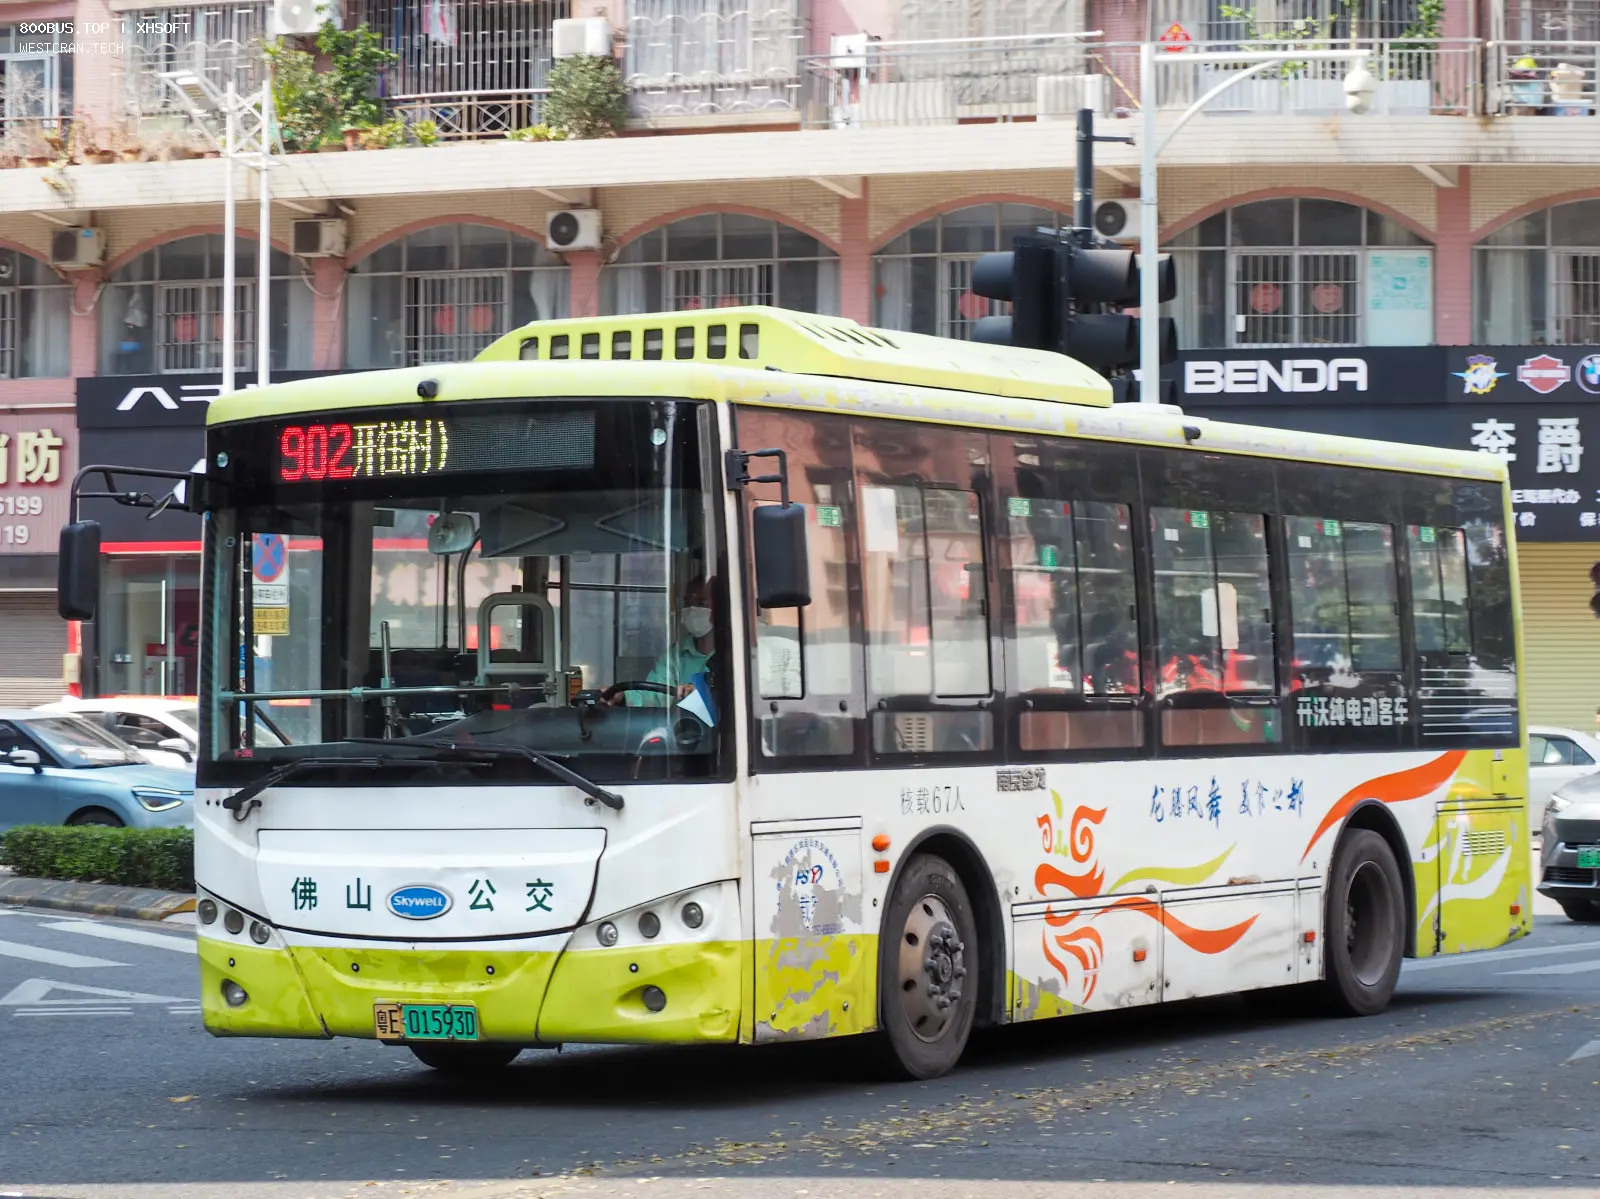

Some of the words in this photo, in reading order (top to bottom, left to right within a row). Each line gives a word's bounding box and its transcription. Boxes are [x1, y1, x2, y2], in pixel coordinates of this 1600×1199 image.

[1184, 358, 1368, 393] BENDA
[281, 424, 352, 480] 902
[0, 524, 29, 544] 19
[1296, 696, 1409, 727] 开沃纯电动客车
[900, 786, 965, 815] 核载67人
[392, 895, 444, 908] Skywell
[408, 1009, 476, 1036] 01593D
